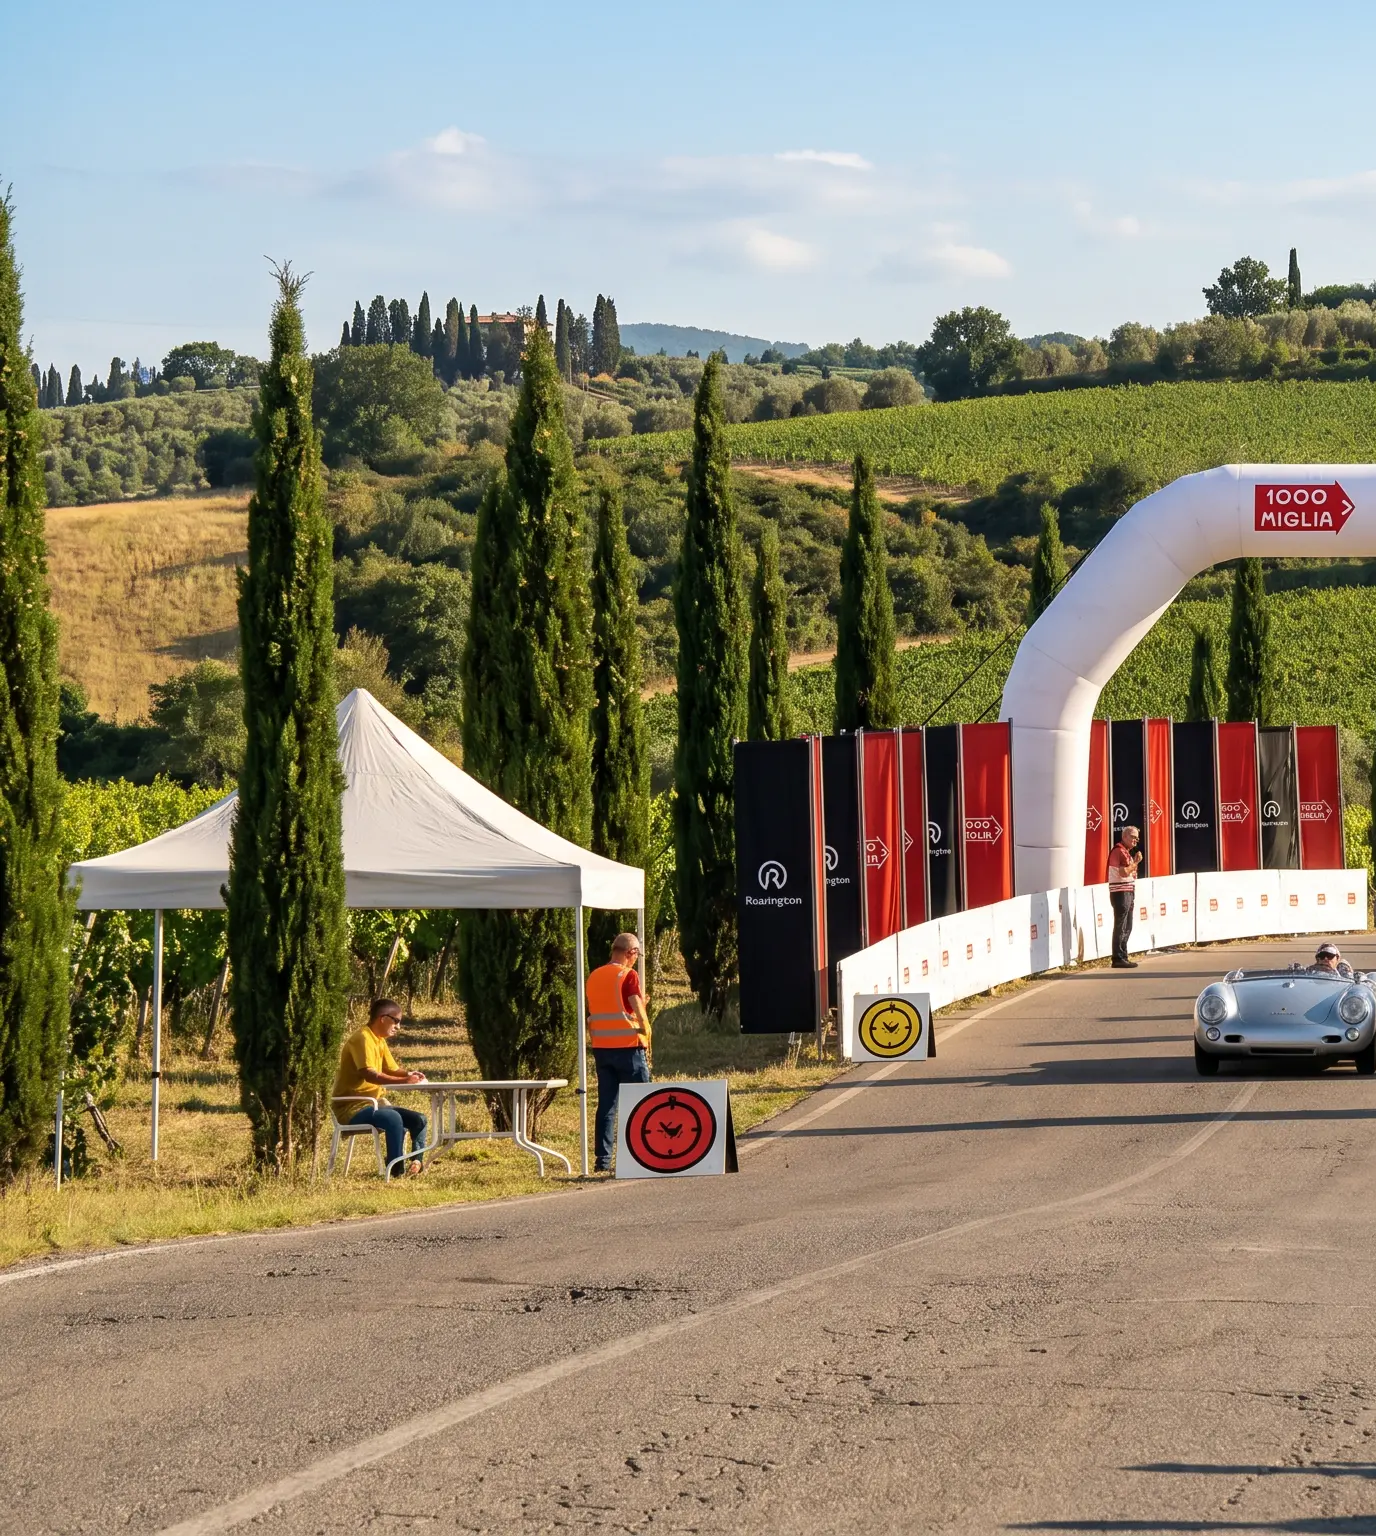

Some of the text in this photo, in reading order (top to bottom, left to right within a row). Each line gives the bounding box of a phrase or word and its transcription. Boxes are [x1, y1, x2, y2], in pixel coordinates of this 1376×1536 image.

[1266, 489, 1327, 505] 1000
[1260, 511, 1333, 527] MIGLIA
[745, 895, 802, 908] Roarington
